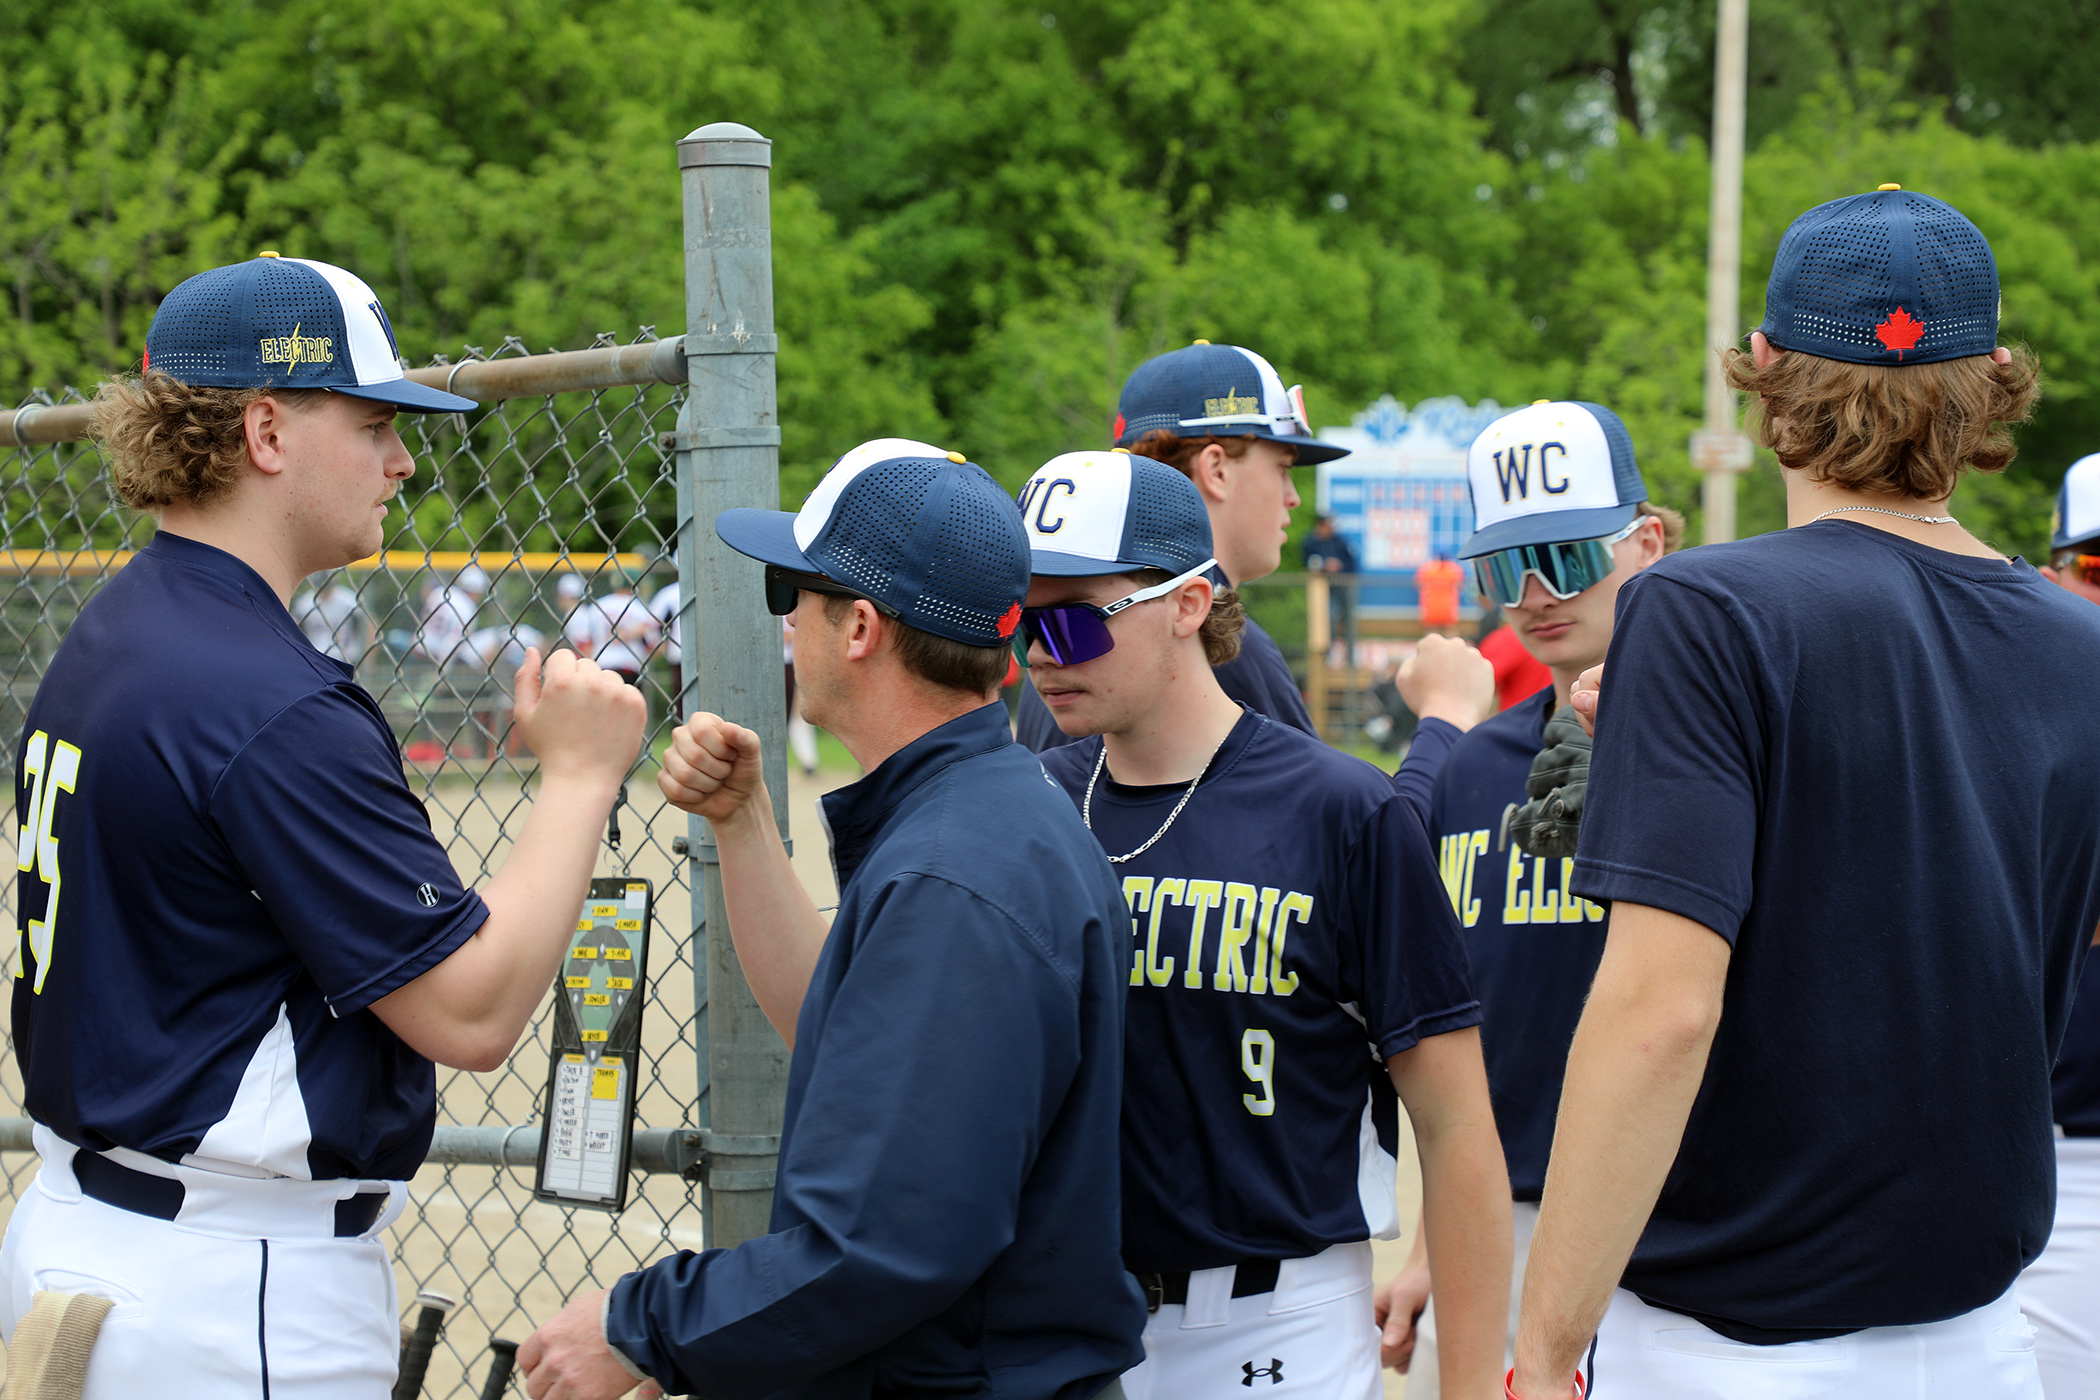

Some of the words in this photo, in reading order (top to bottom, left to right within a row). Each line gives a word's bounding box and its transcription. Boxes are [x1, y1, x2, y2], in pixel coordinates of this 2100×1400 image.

[260, 336, 334, 364] ELECTRIC
[1492, 440, 1571, 504] WC
[1502, 842, 1606, 925] ELE
[1241, 1028, 1276, 1117] 9
